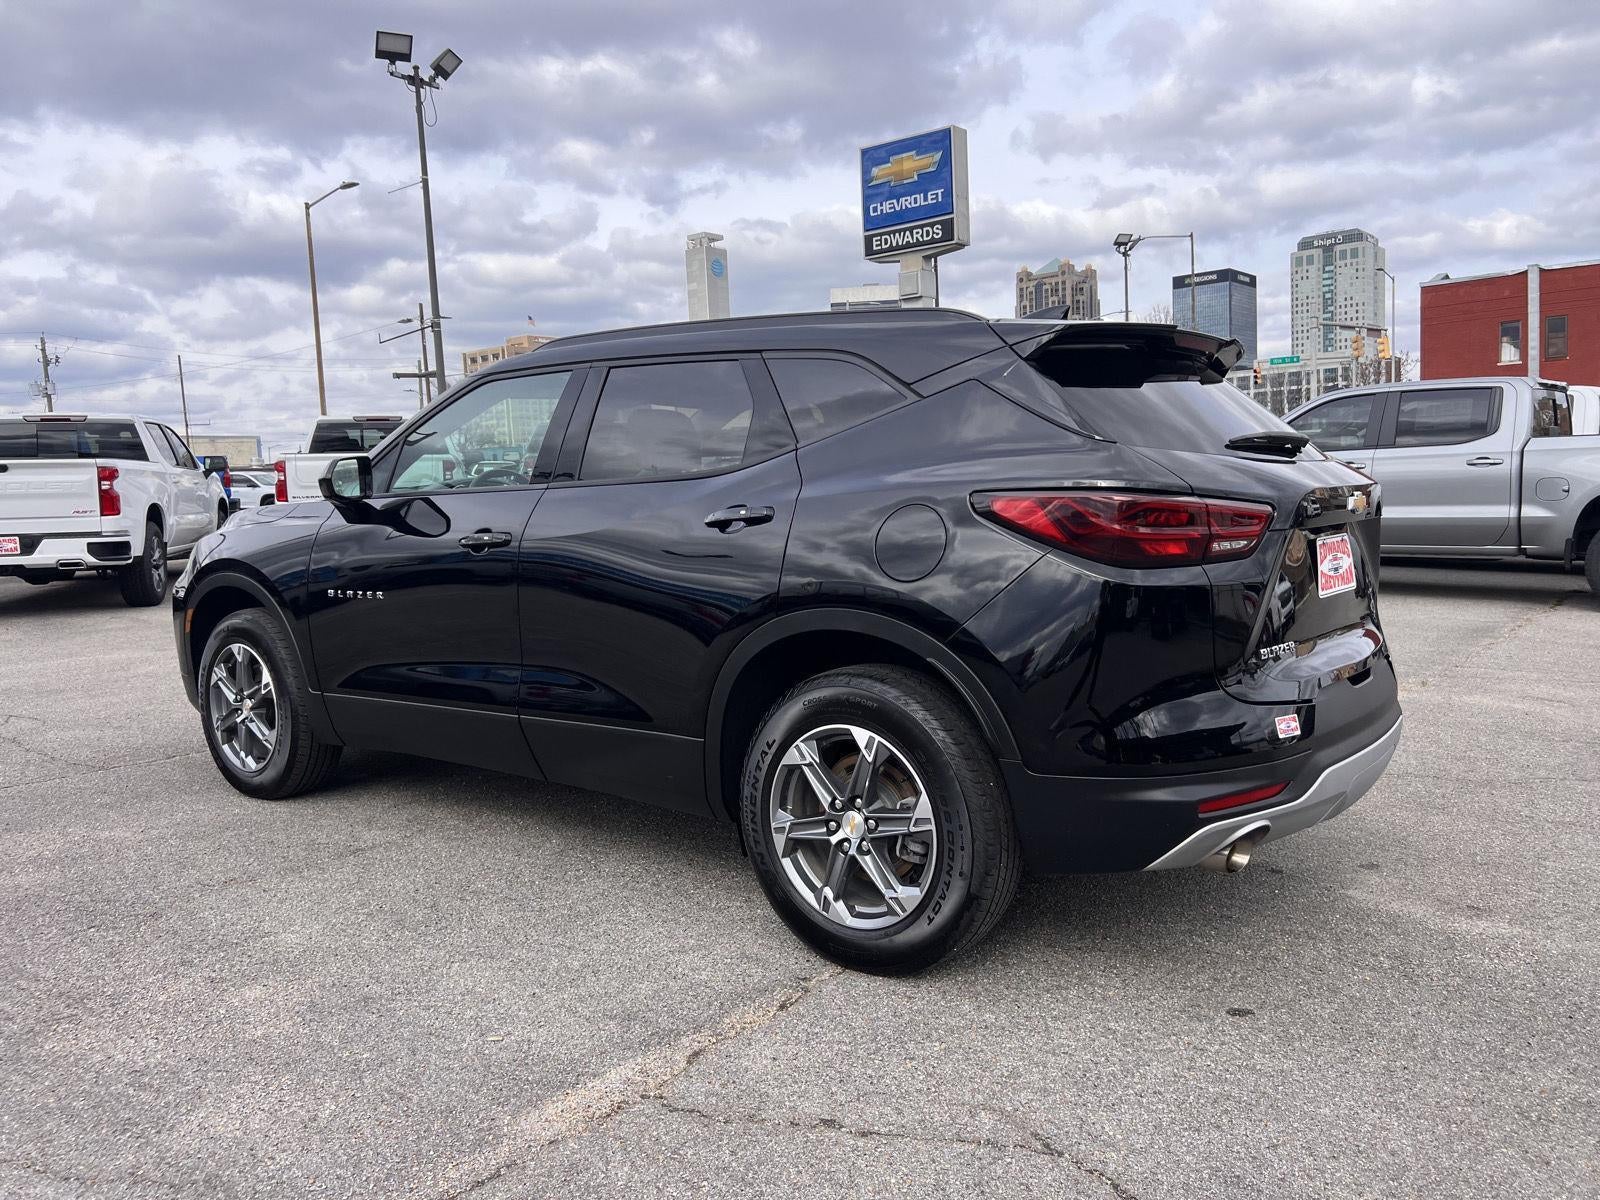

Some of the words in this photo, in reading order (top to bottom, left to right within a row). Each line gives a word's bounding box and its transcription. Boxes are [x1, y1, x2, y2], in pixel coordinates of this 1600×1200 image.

[869, 188, 945, 217] CHEVROLET
[872, 224, 943, 251] EDWARDS
[1313, 238, 1336, 247] Shipt
[1319, 540, 1351, 567] EDWARDS
[1320, 562, 1355, 592] CHEVYMAN
[327, 589, 385, 600] BLAZER
[1260, 641, 1296, 660] BLAZER
